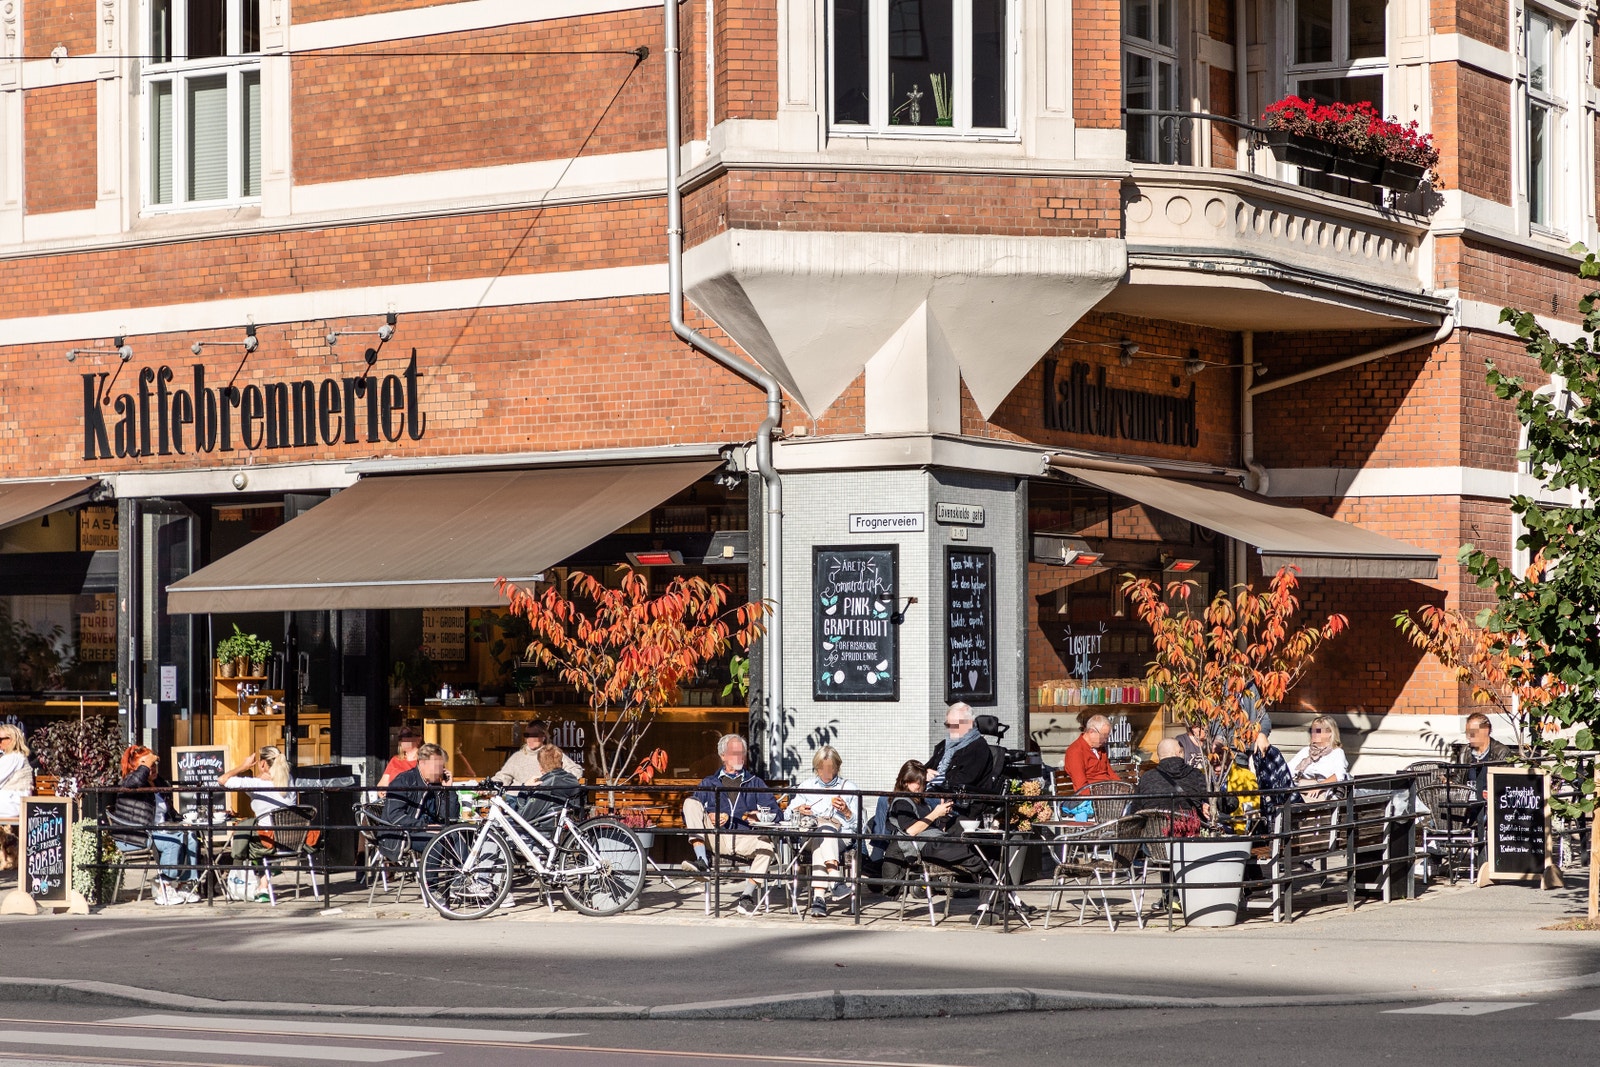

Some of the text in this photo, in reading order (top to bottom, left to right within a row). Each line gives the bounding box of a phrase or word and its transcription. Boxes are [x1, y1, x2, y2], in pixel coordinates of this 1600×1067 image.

[81, 347, 426, 461] Kaffebrenneriet
[1044, 358, 1199, 448] Kaffebrenneriet
[856, 516, 918, 530] Frognerveien
[972, 509, 983, 523] gate
[842, 559, 867, 572] ÅRETS
[844, 597, 870, 616] PINK
[824, 619, 889, 637] GRAPEFRUIT
[28, 816, 63, 847] ISKREM
